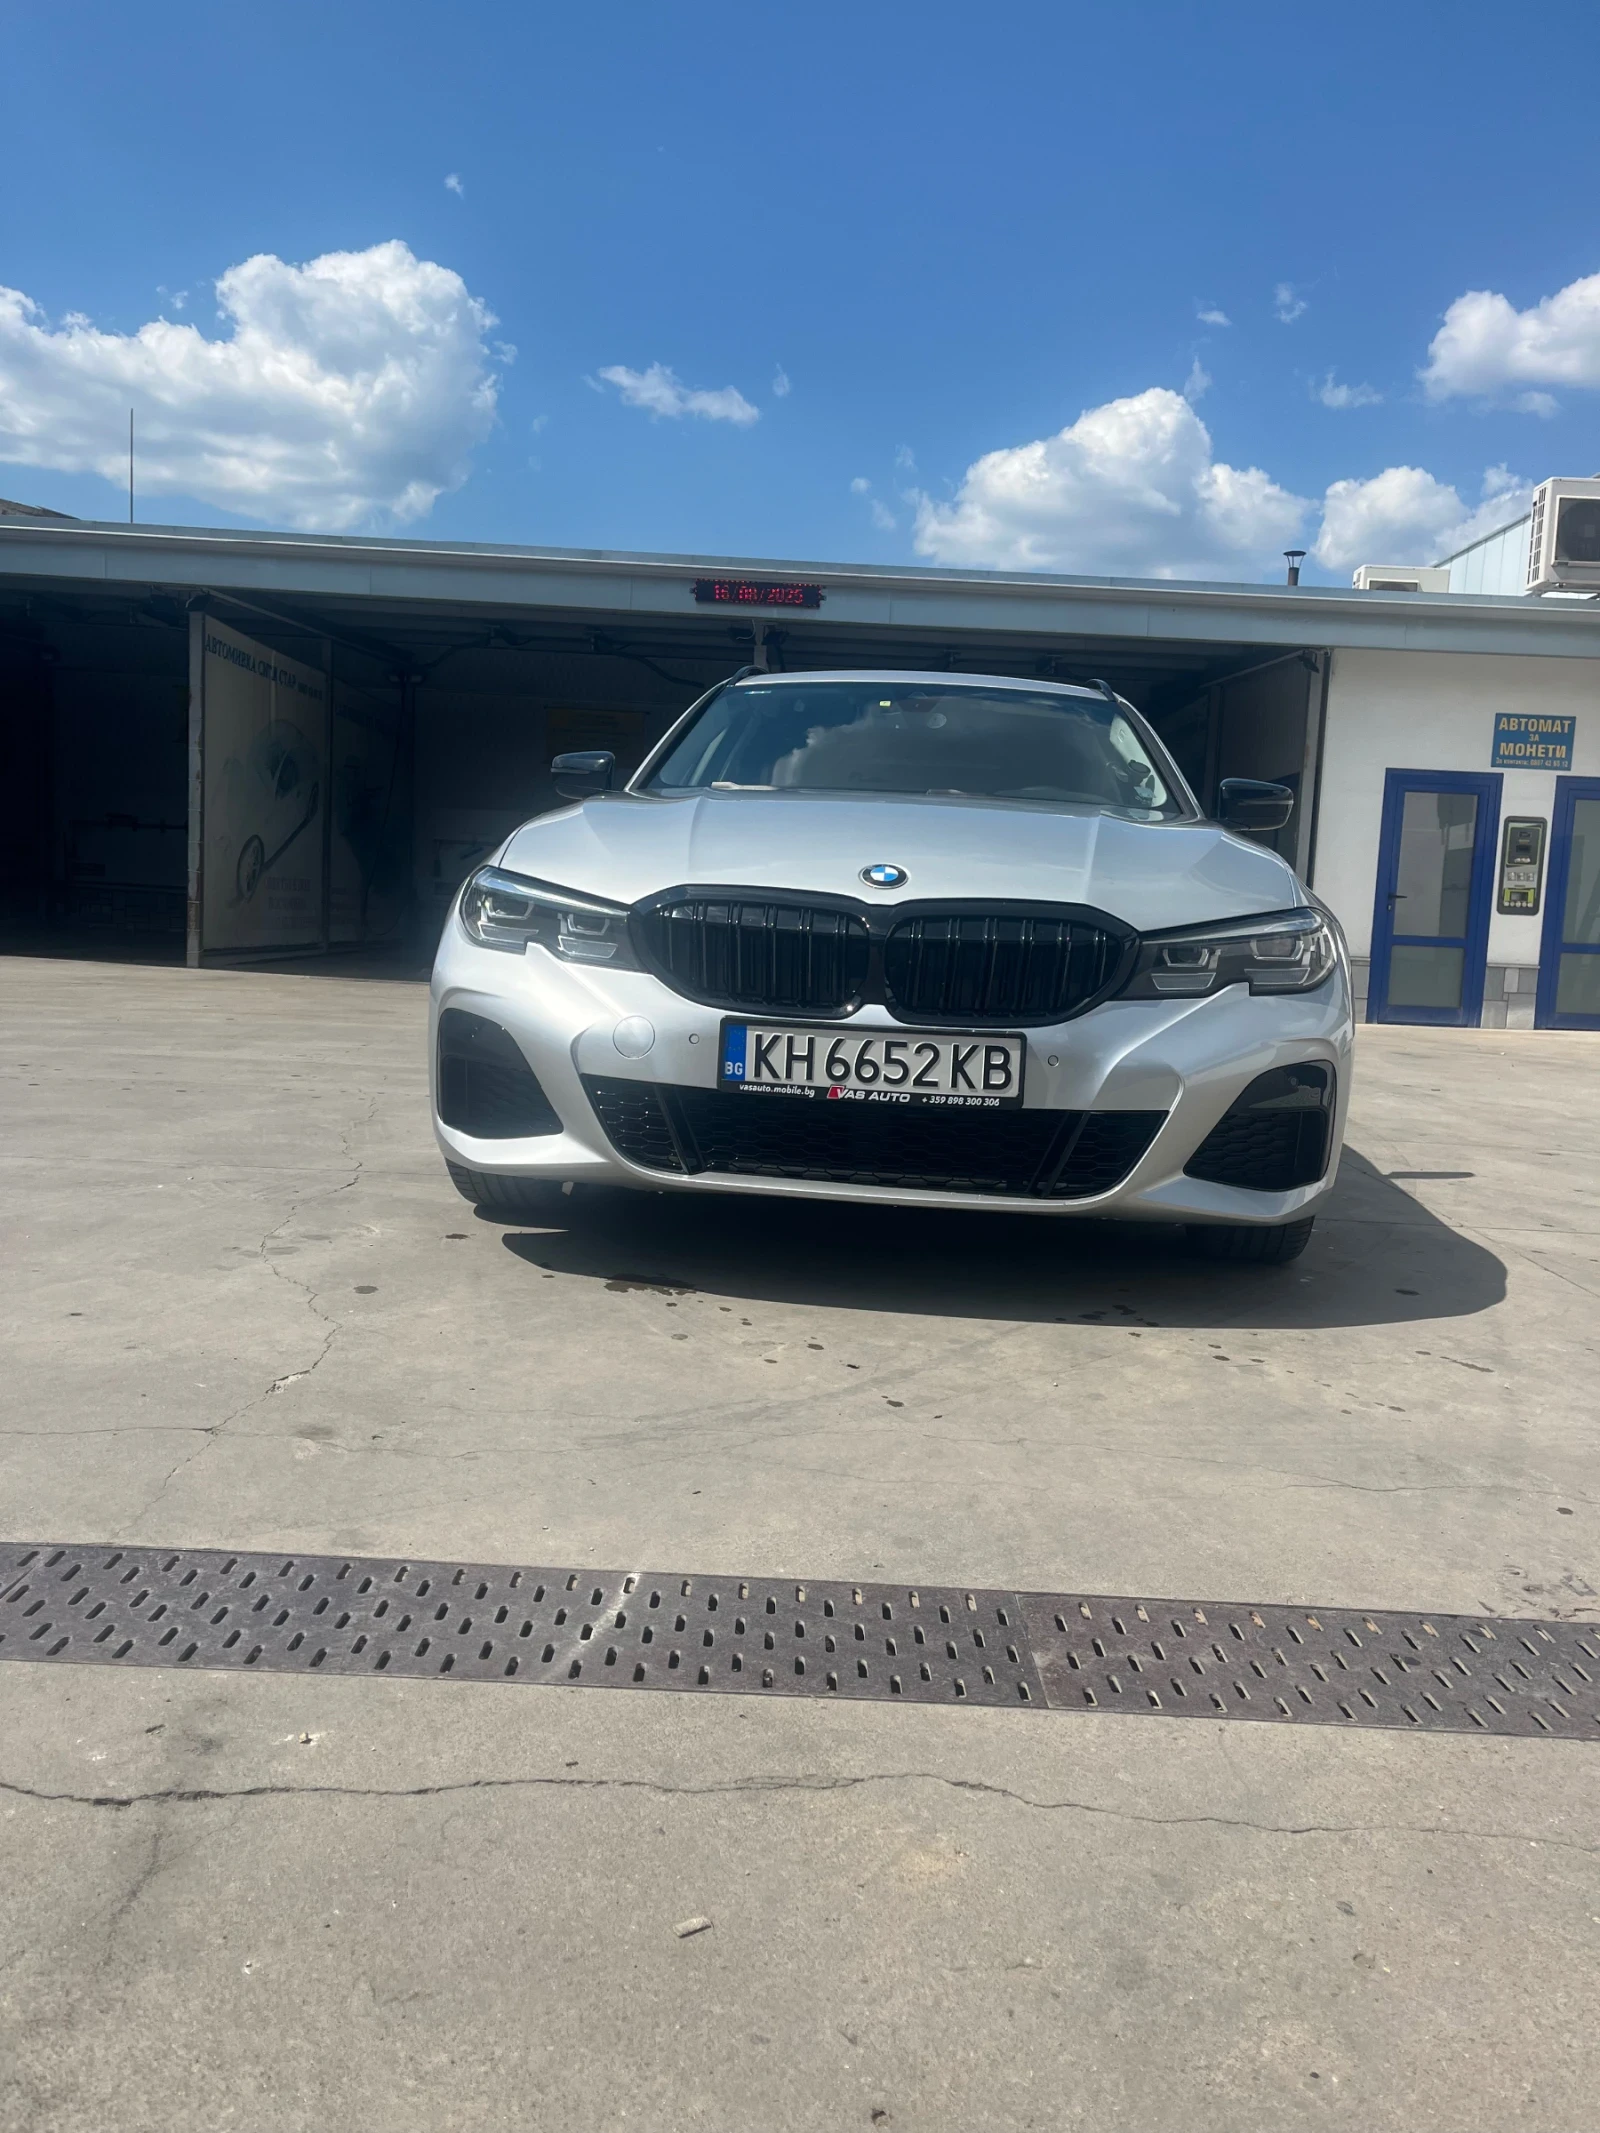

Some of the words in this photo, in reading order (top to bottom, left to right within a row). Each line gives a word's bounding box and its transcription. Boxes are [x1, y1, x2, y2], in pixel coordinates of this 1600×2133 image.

[1499, 718, 1571, 733] АВТОМАТ
[1529, 734, 1539, 742] ЗА
[1500, 742, 1566, 758] МОНЕТИ
[725, 1061, 743, 1076] BG
[739, 1083, 816, 1098] vasauto.mobile.bg
[836, 1088, 866, 1100] VAS
[868, 1091, 911, 1103] AUTO
